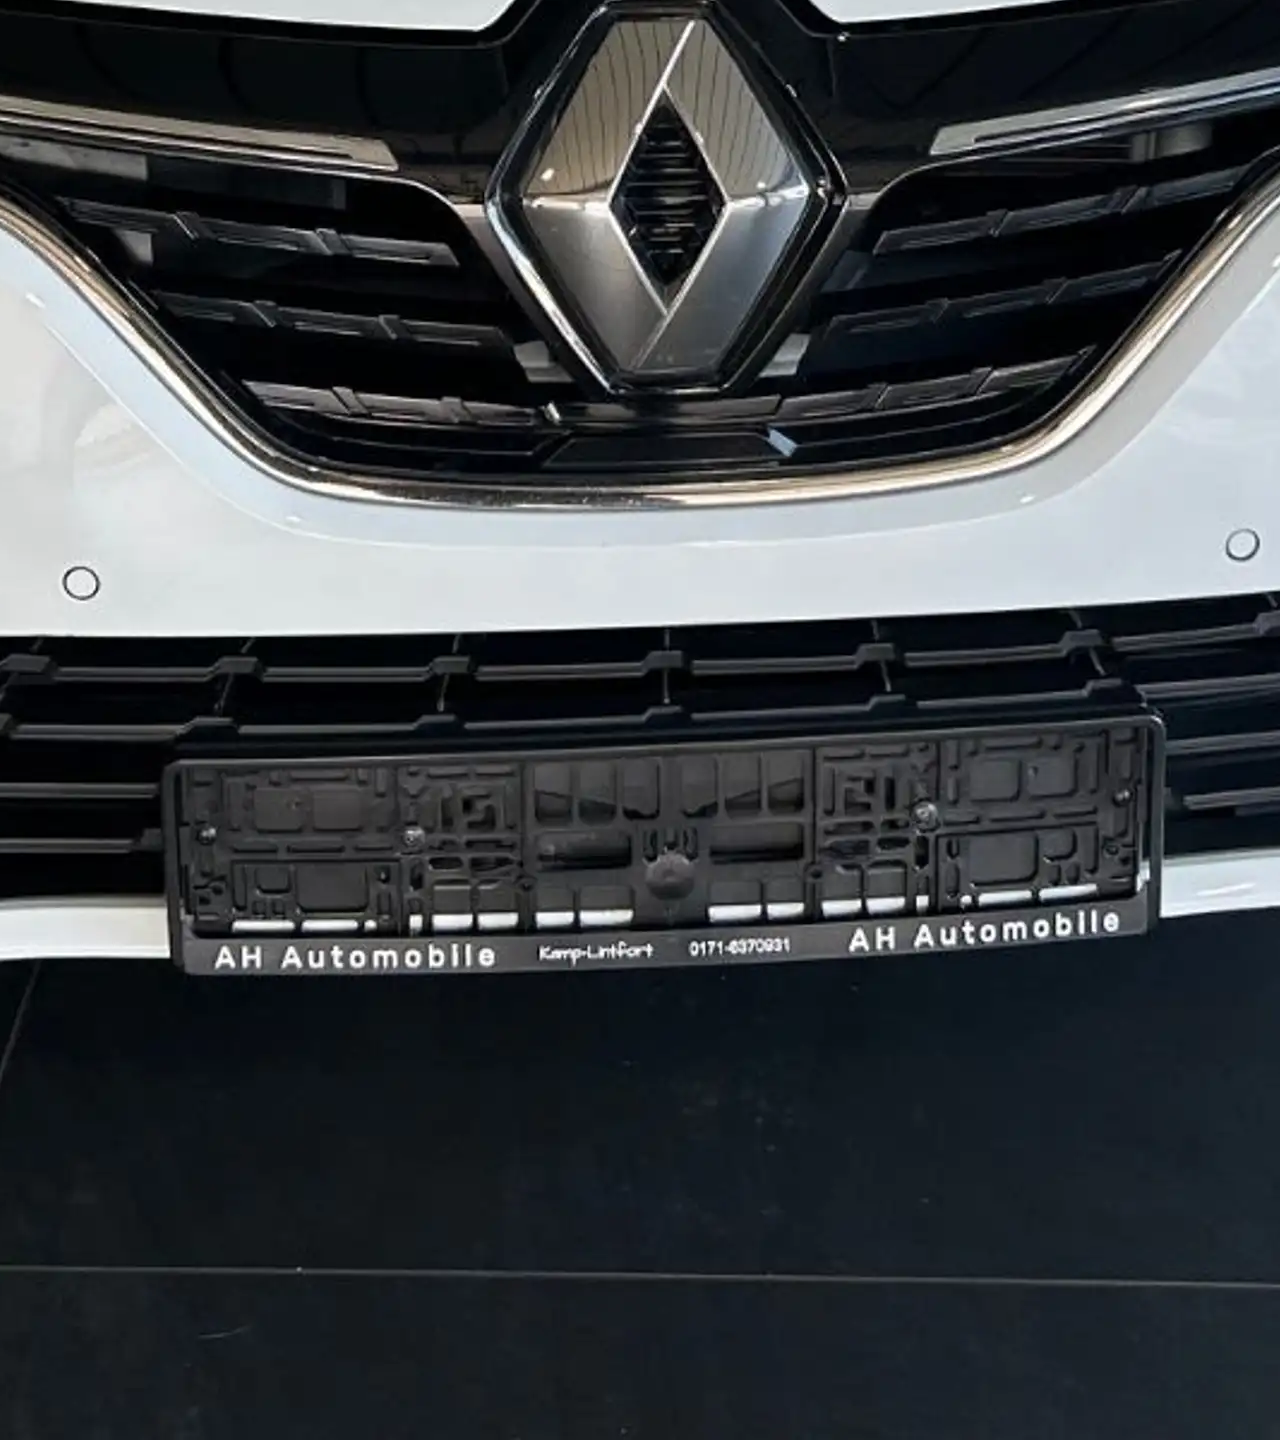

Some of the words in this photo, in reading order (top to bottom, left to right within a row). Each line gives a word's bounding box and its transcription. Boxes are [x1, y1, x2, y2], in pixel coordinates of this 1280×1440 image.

[848, 926, 897, 953] AH
[913, 910, 1121, 949] Automobile
[214, 944, 262, 970] AH
[280, 943, 496, 969] Automobile
